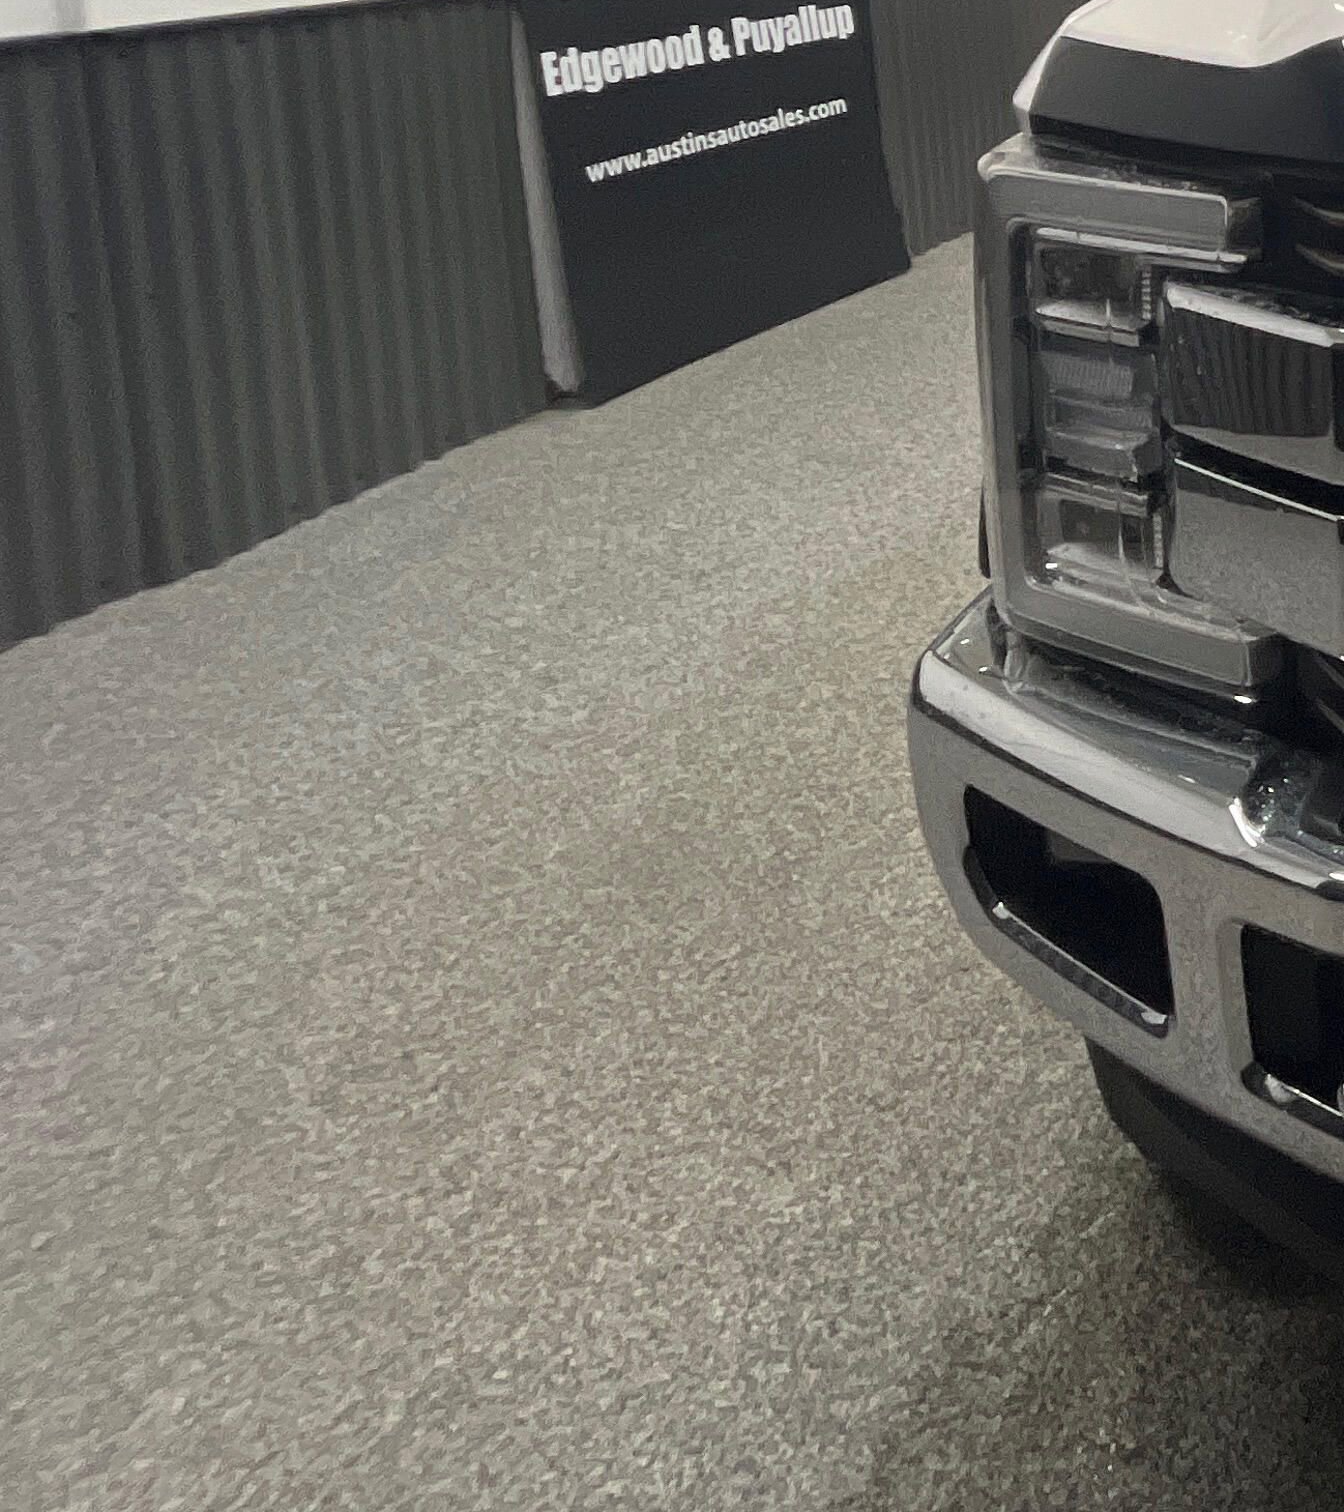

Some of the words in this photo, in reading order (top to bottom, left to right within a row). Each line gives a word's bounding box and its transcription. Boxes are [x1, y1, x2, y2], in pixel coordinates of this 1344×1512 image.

[540, 24, 704, 97] Edgewood
[707, 25, 730, 62] &
[731, 3, 856, 59] Puyallup
[585, 96, 848, 184] www.austinsautosales.com
